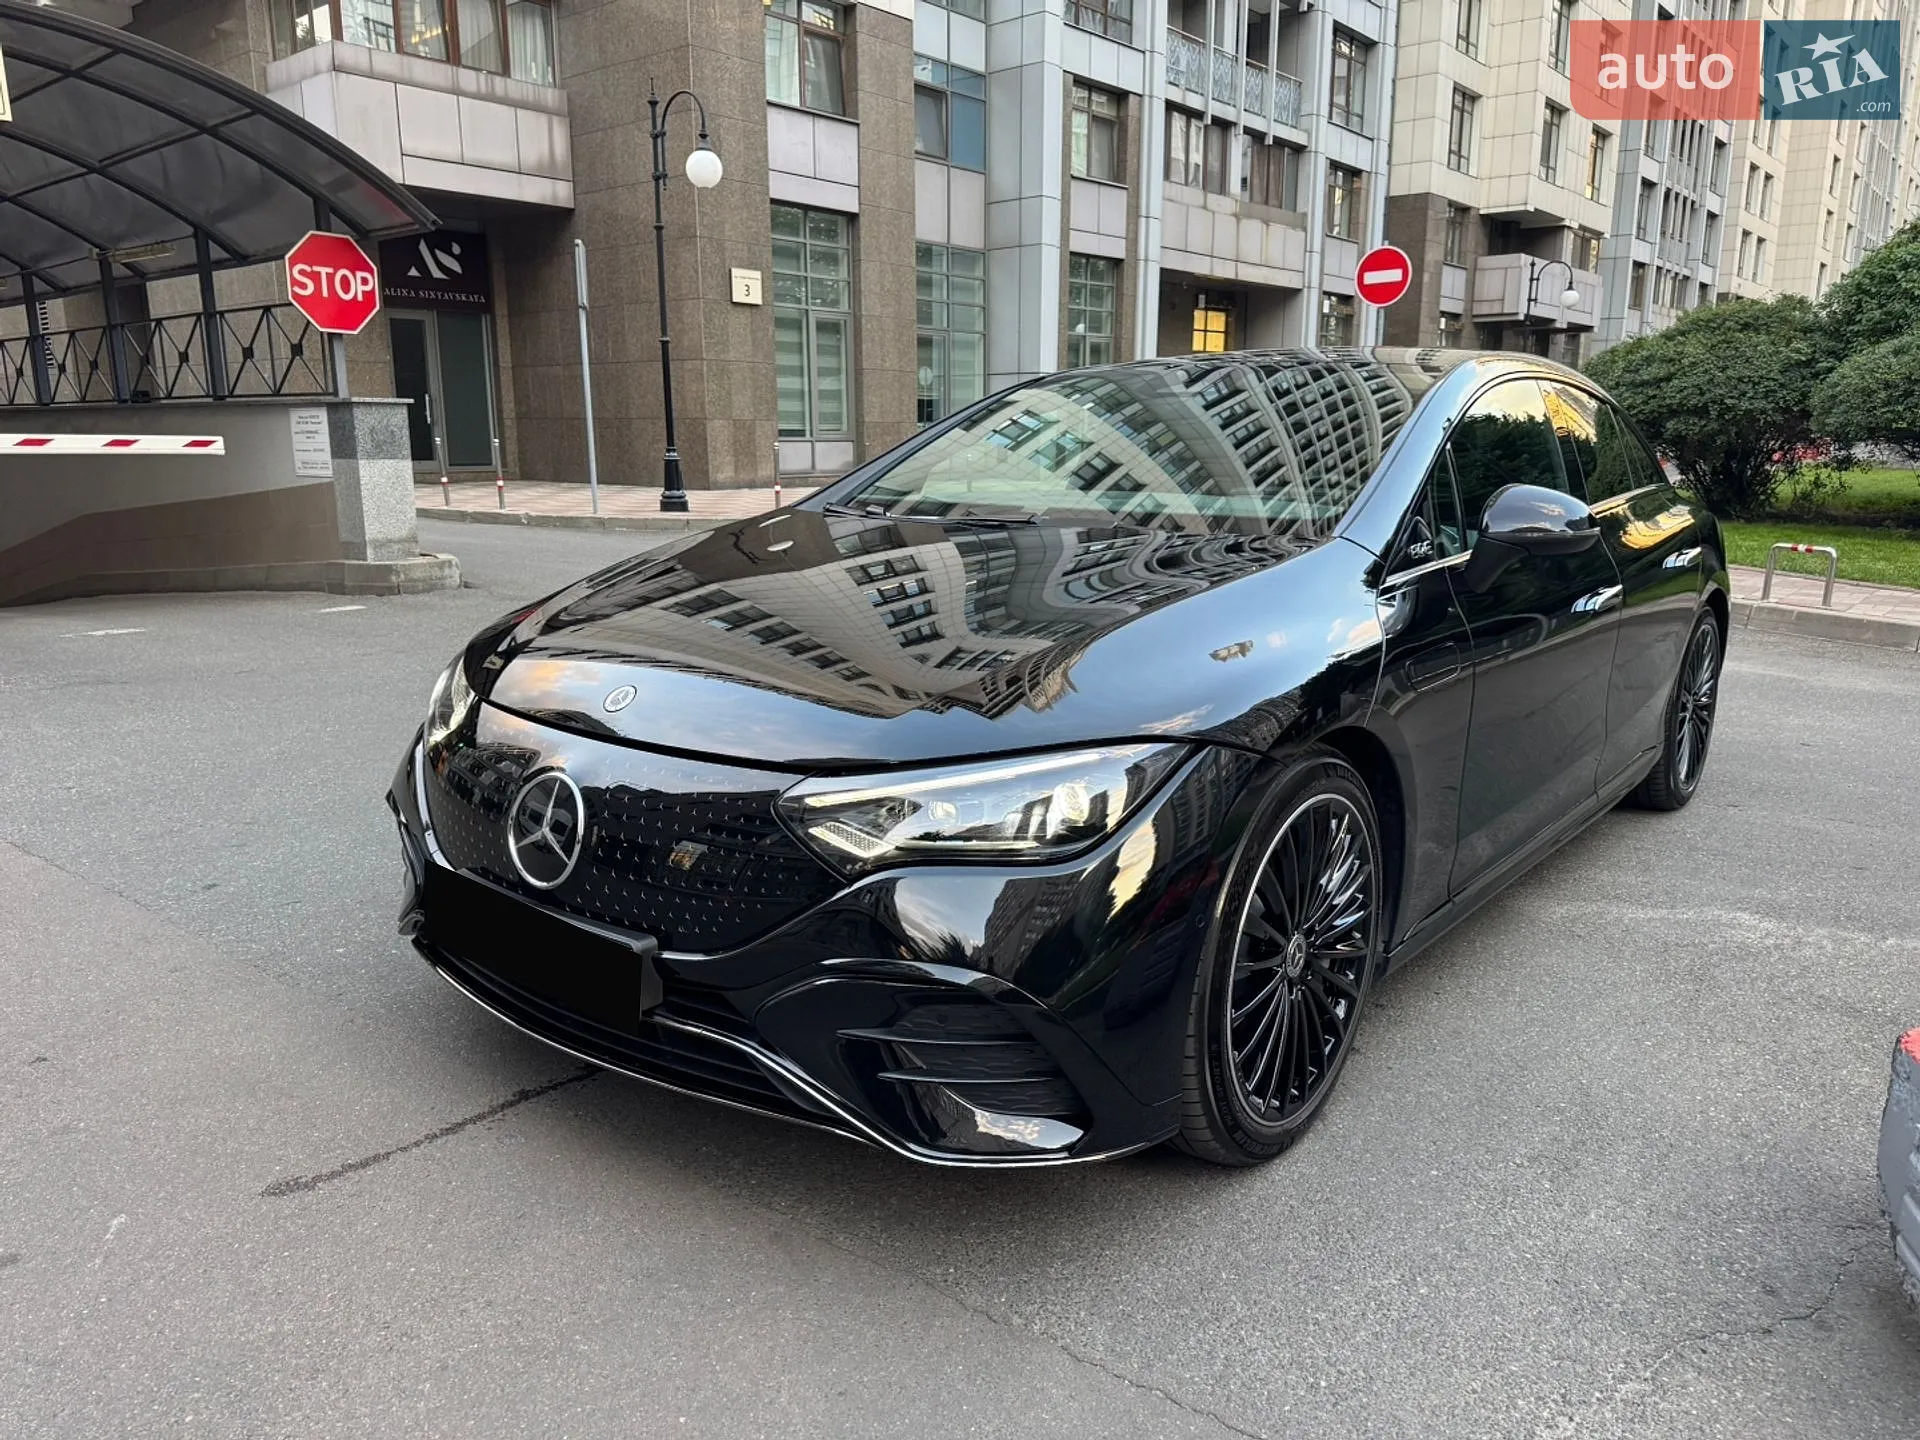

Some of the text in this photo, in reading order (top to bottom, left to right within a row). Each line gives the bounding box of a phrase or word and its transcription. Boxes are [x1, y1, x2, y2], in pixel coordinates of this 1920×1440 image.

[292, 264, 374, 302] STOP
[384, 288, 416, 297] ALINA
[744, 284, 751, 297] 3
